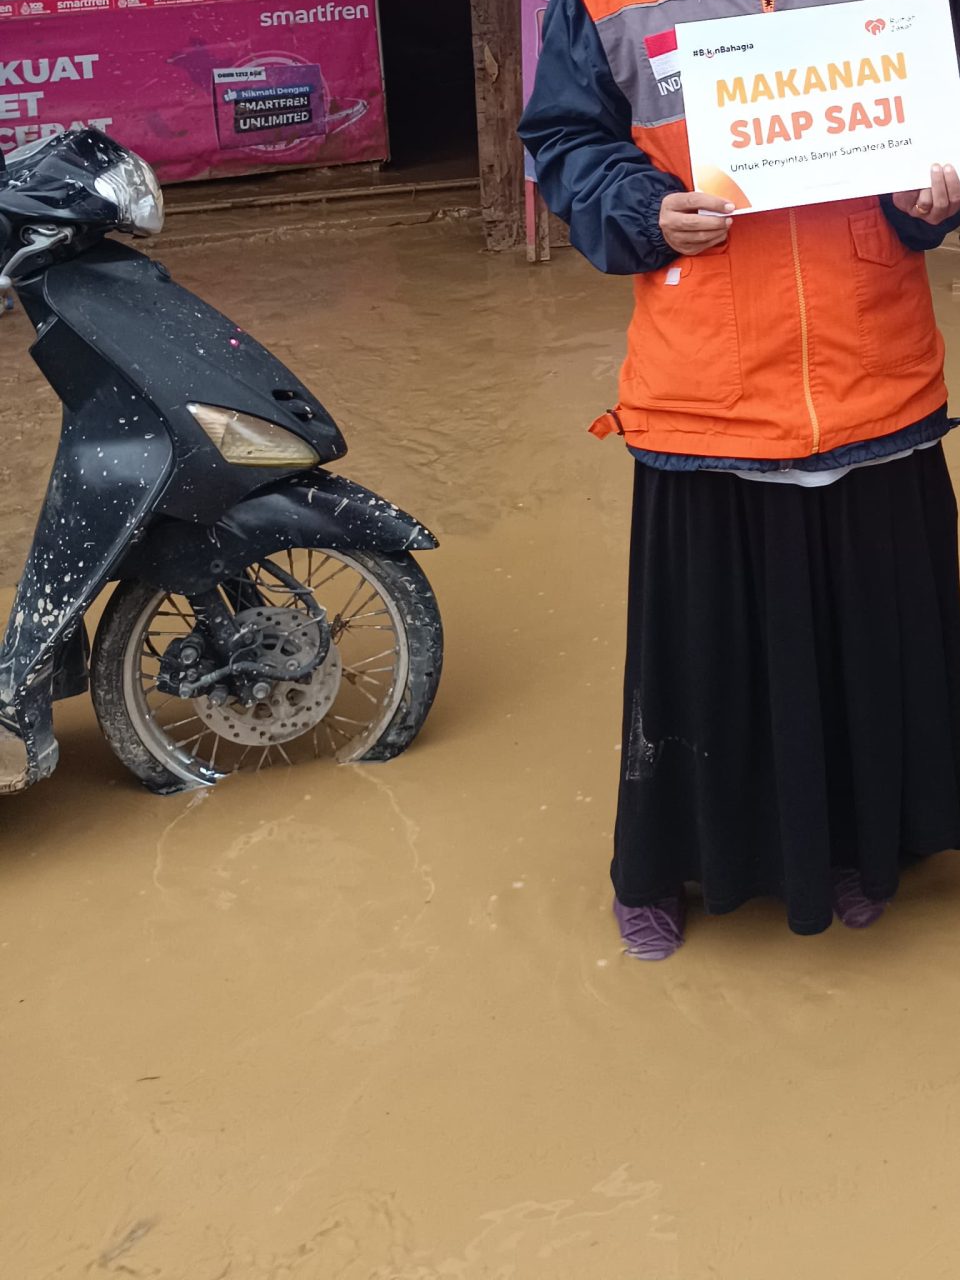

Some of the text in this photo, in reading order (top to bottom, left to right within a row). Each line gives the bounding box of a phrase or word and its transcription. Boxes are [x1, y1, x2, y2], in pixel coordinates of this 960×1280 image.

[260, 2, 369, 27] smartfren
[693, 43, 754, 58] #BknBahagia
[0, 54, 99, 86] KUAT
[715, 52, 908, 108] MAKANAN
[241, 86, 309, 98] Nikmati Dengan
[657, 76, 681, 96] IND
[239, 111, 309, 130] UNLIMITED
[729, 95, 905, 149] SIAP SAJI
[730, 137, 913, 173] Untuk Penyintas Banjir Sumatera Barat
